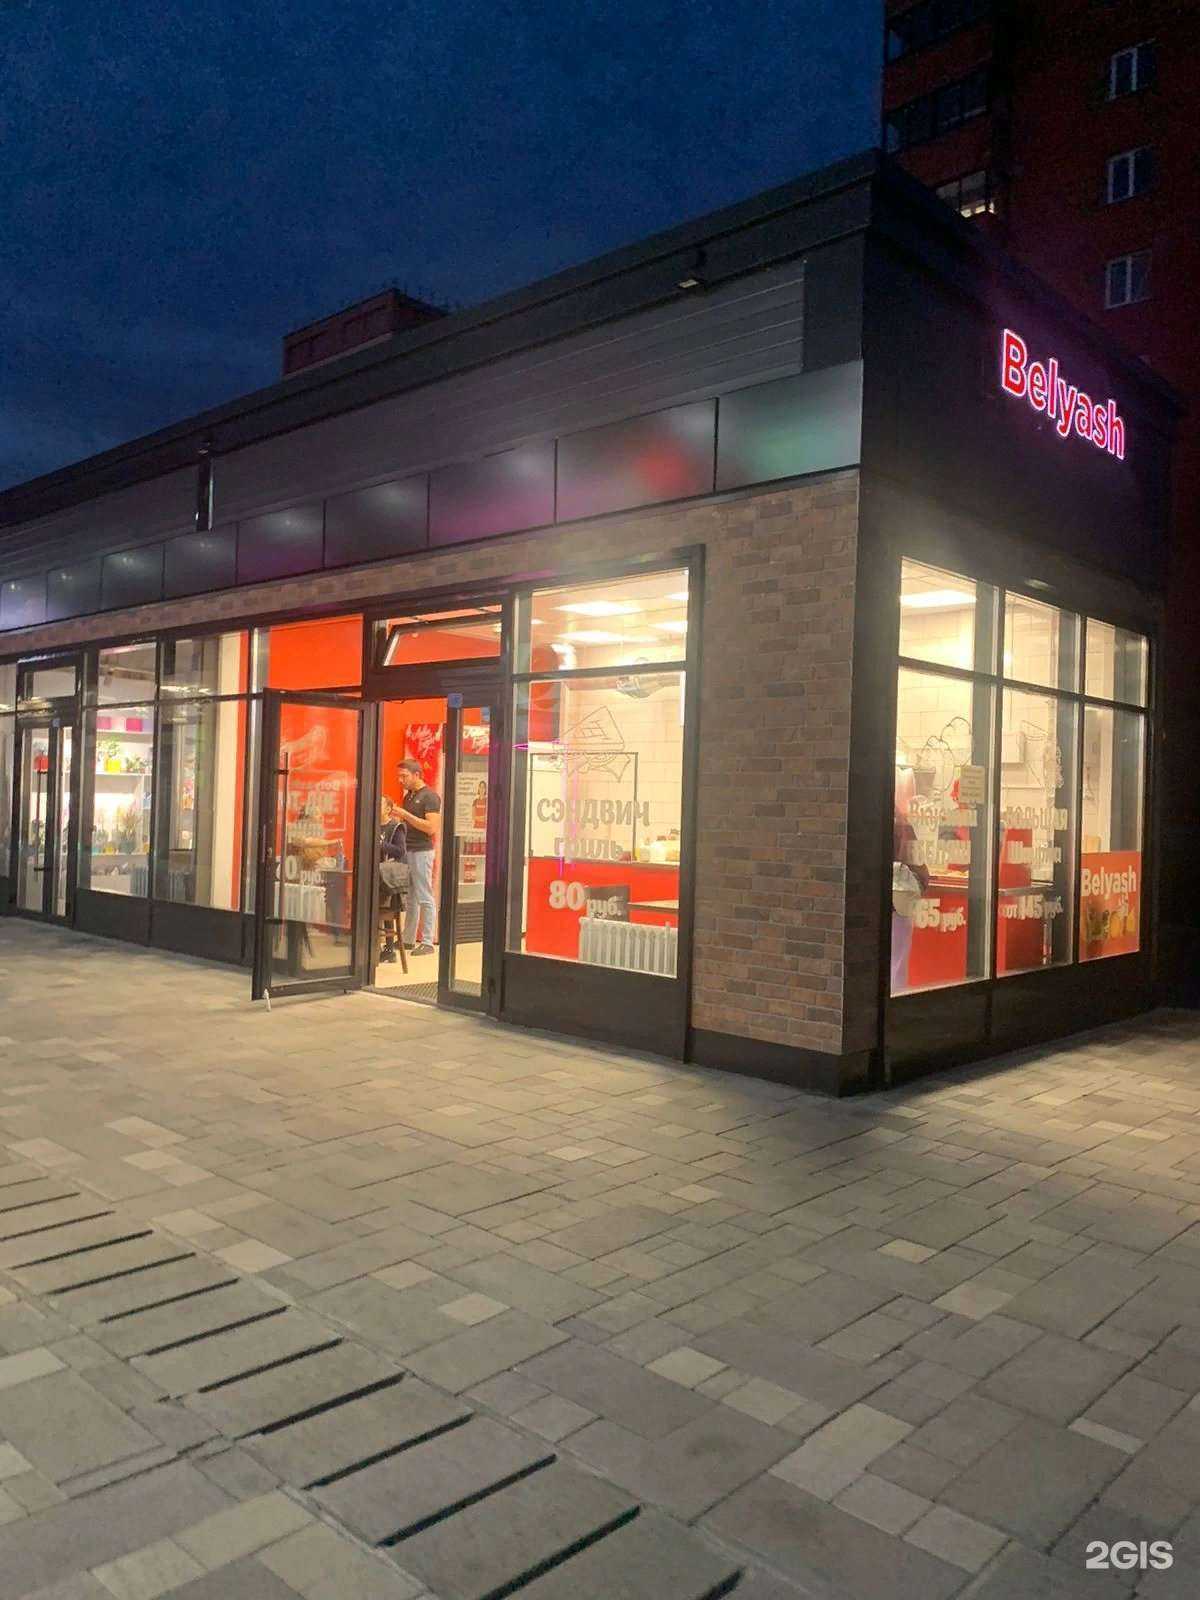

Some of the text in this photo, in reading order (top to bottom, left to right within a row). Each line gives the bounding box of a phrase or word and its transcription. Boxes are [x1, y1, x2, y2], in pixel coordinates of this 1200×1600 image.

[1002, 328, 1125, 460] Belyash
[549, 880, 623, 918] 80 руб.
[1080, 865, 1137, 900] Belyash
